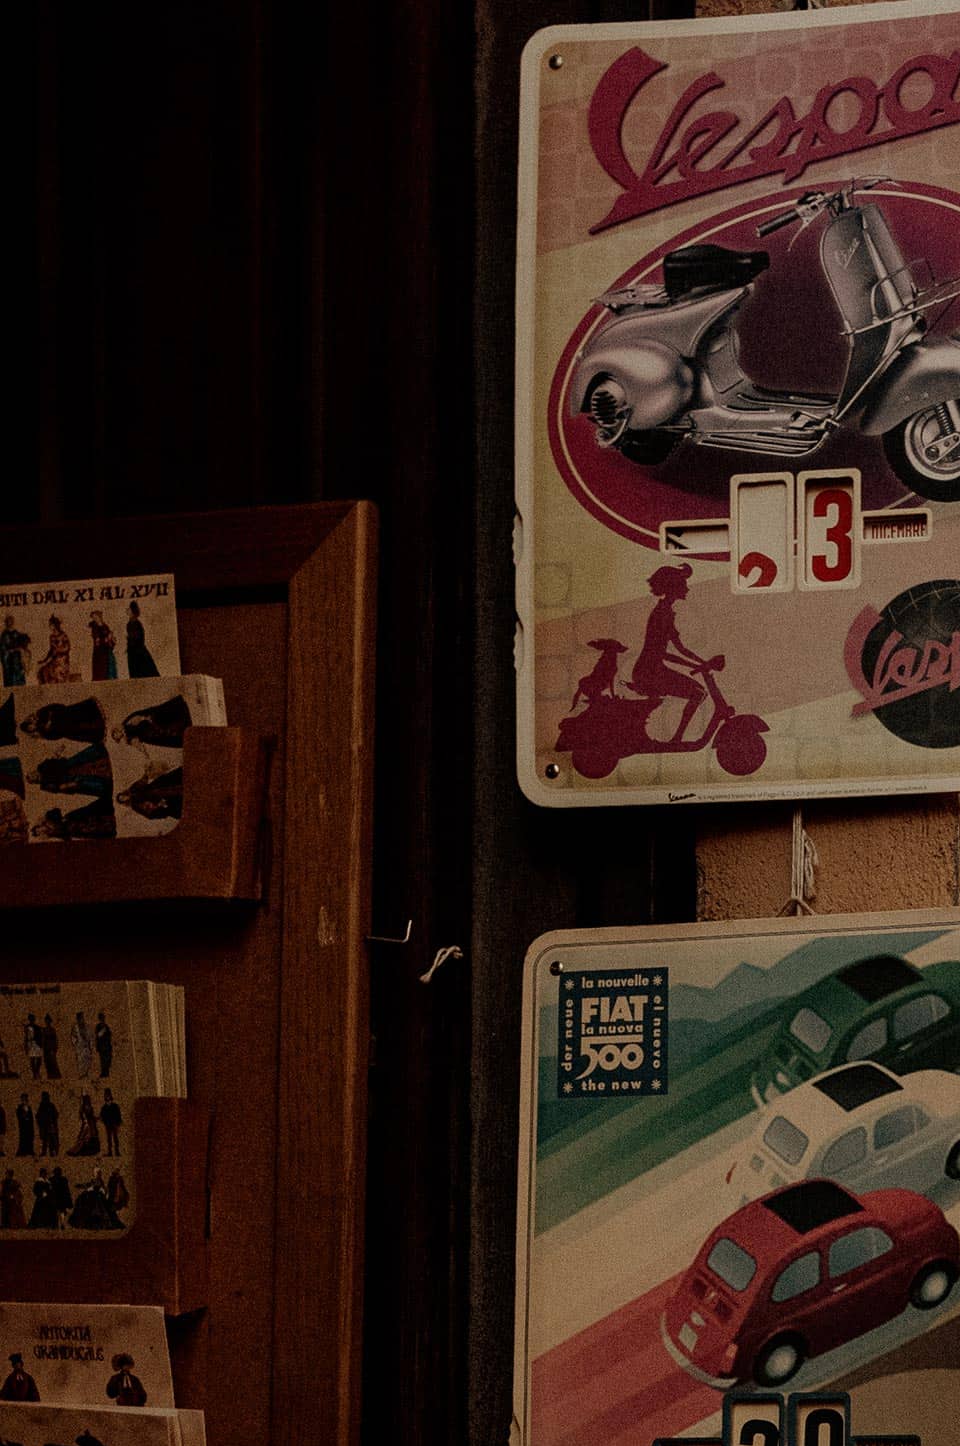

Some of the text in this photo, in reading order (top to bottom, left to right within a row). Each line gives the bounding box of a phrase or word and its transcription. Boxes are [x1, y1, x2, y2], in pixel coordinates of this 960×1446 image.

[812, 489, 852, 582] 3
[32, 589, 69, 605] DAL
[73, 587, 94, 602] XI
[100, 586, 125, 600] AL
[131, 582, 168, 599] XVII
[581, 973, 650, 989] la nouvelle
[581, 994, 649, 1024] FIAT
[560, 998, 574, 1072] der neue
[581, 1024, 644, 1035] la nuova
[652, 995, 665, 1070] el nuevo
[574, 1034, 645, 1081] 500
[580, 1079, 642, 1092] the new
